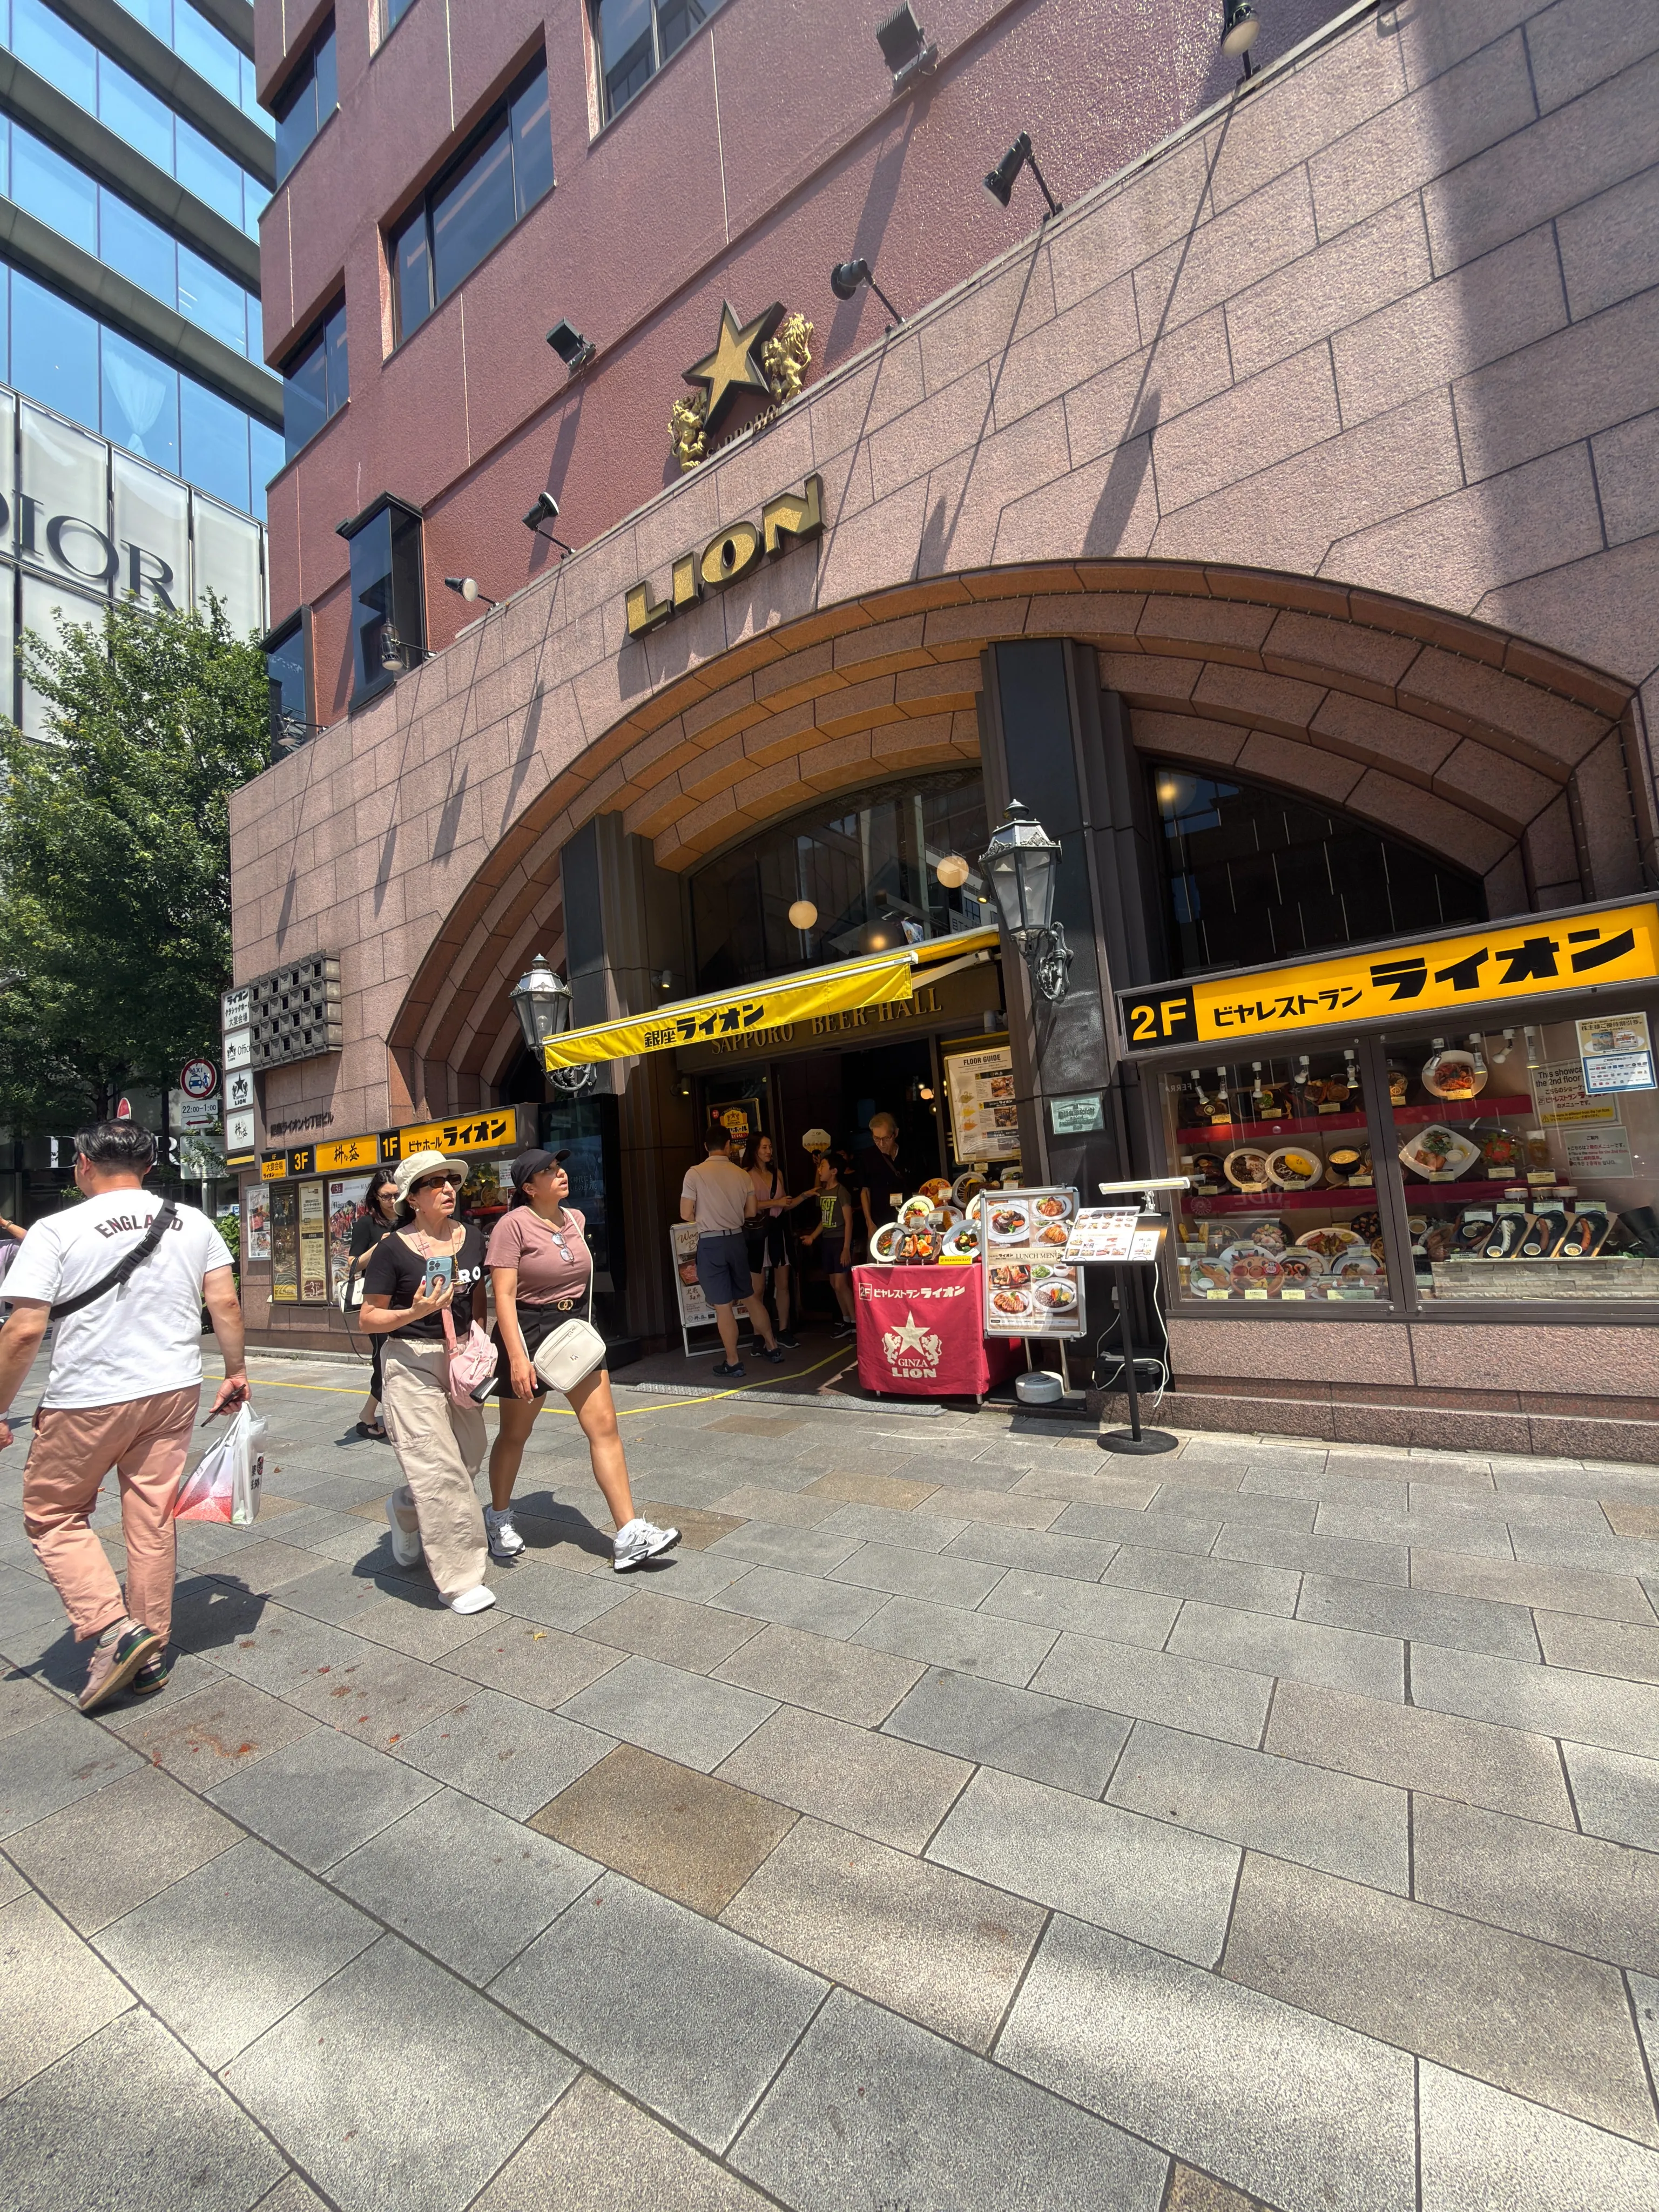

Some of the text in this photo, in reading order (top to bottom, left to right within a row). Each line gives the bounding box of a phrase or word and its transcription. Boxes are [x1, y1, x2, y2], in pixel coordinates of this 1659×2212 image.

[626, 473, 827, 639] LION
[227, 990, 248, 1006] ライオン
[229, 1013, 247, 1027] 大宴会場
[644, 1004, 764, 1048] 銀座ライオン
[1131, 999, 1188, 1041] 2F
[712, 1022, 794, 1055] SAPPORO
[963, 1054, 1001, 1065] FLOOR GUIDE
[1555, 1067, 1582, 1076] showca
[1557, 1100, 1591, 1108] のメニューです。
[382, 1137, 397, 1157] 1F
[266, 1161, 283, 1172] 大宴会場
[294, 1152, 308, 1170] 3F
[94, 1215, 184, 1239] ENGLAD
[677, 1230, 698, 1243] Wag
[860, 1287, 870, 1296] 2F
[898, 1358, 929, 1367] GINZA
[892, 1367, 937, 1378] LION
